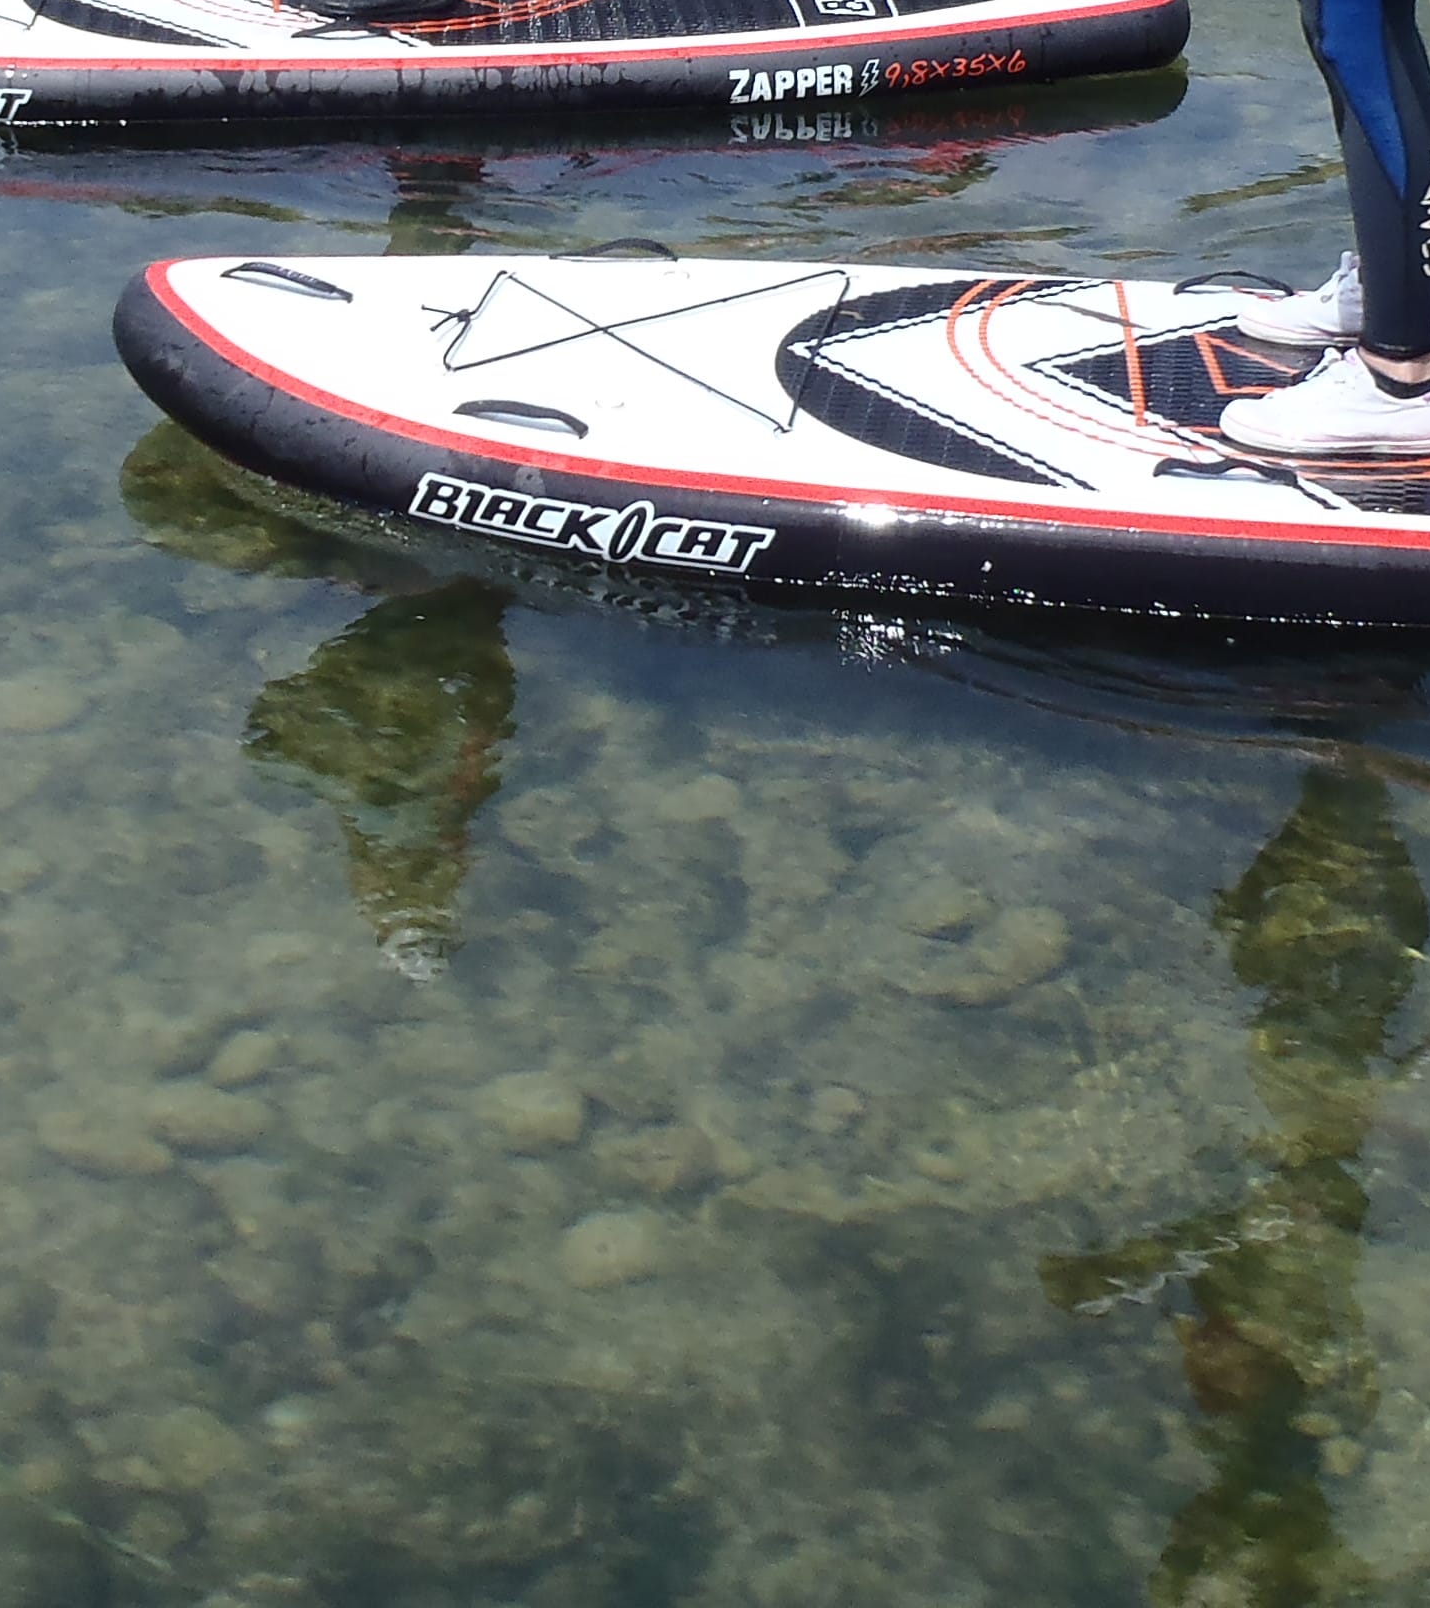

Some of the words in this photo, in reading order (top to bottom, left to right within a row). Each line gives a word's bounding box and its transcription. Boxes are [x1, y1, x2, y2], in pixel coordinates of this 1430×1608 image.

[729, 64, 853, 104] ZAPPER
[414, 478, 606, 553] BLACK
[640, 524, 769, 568] CAT
